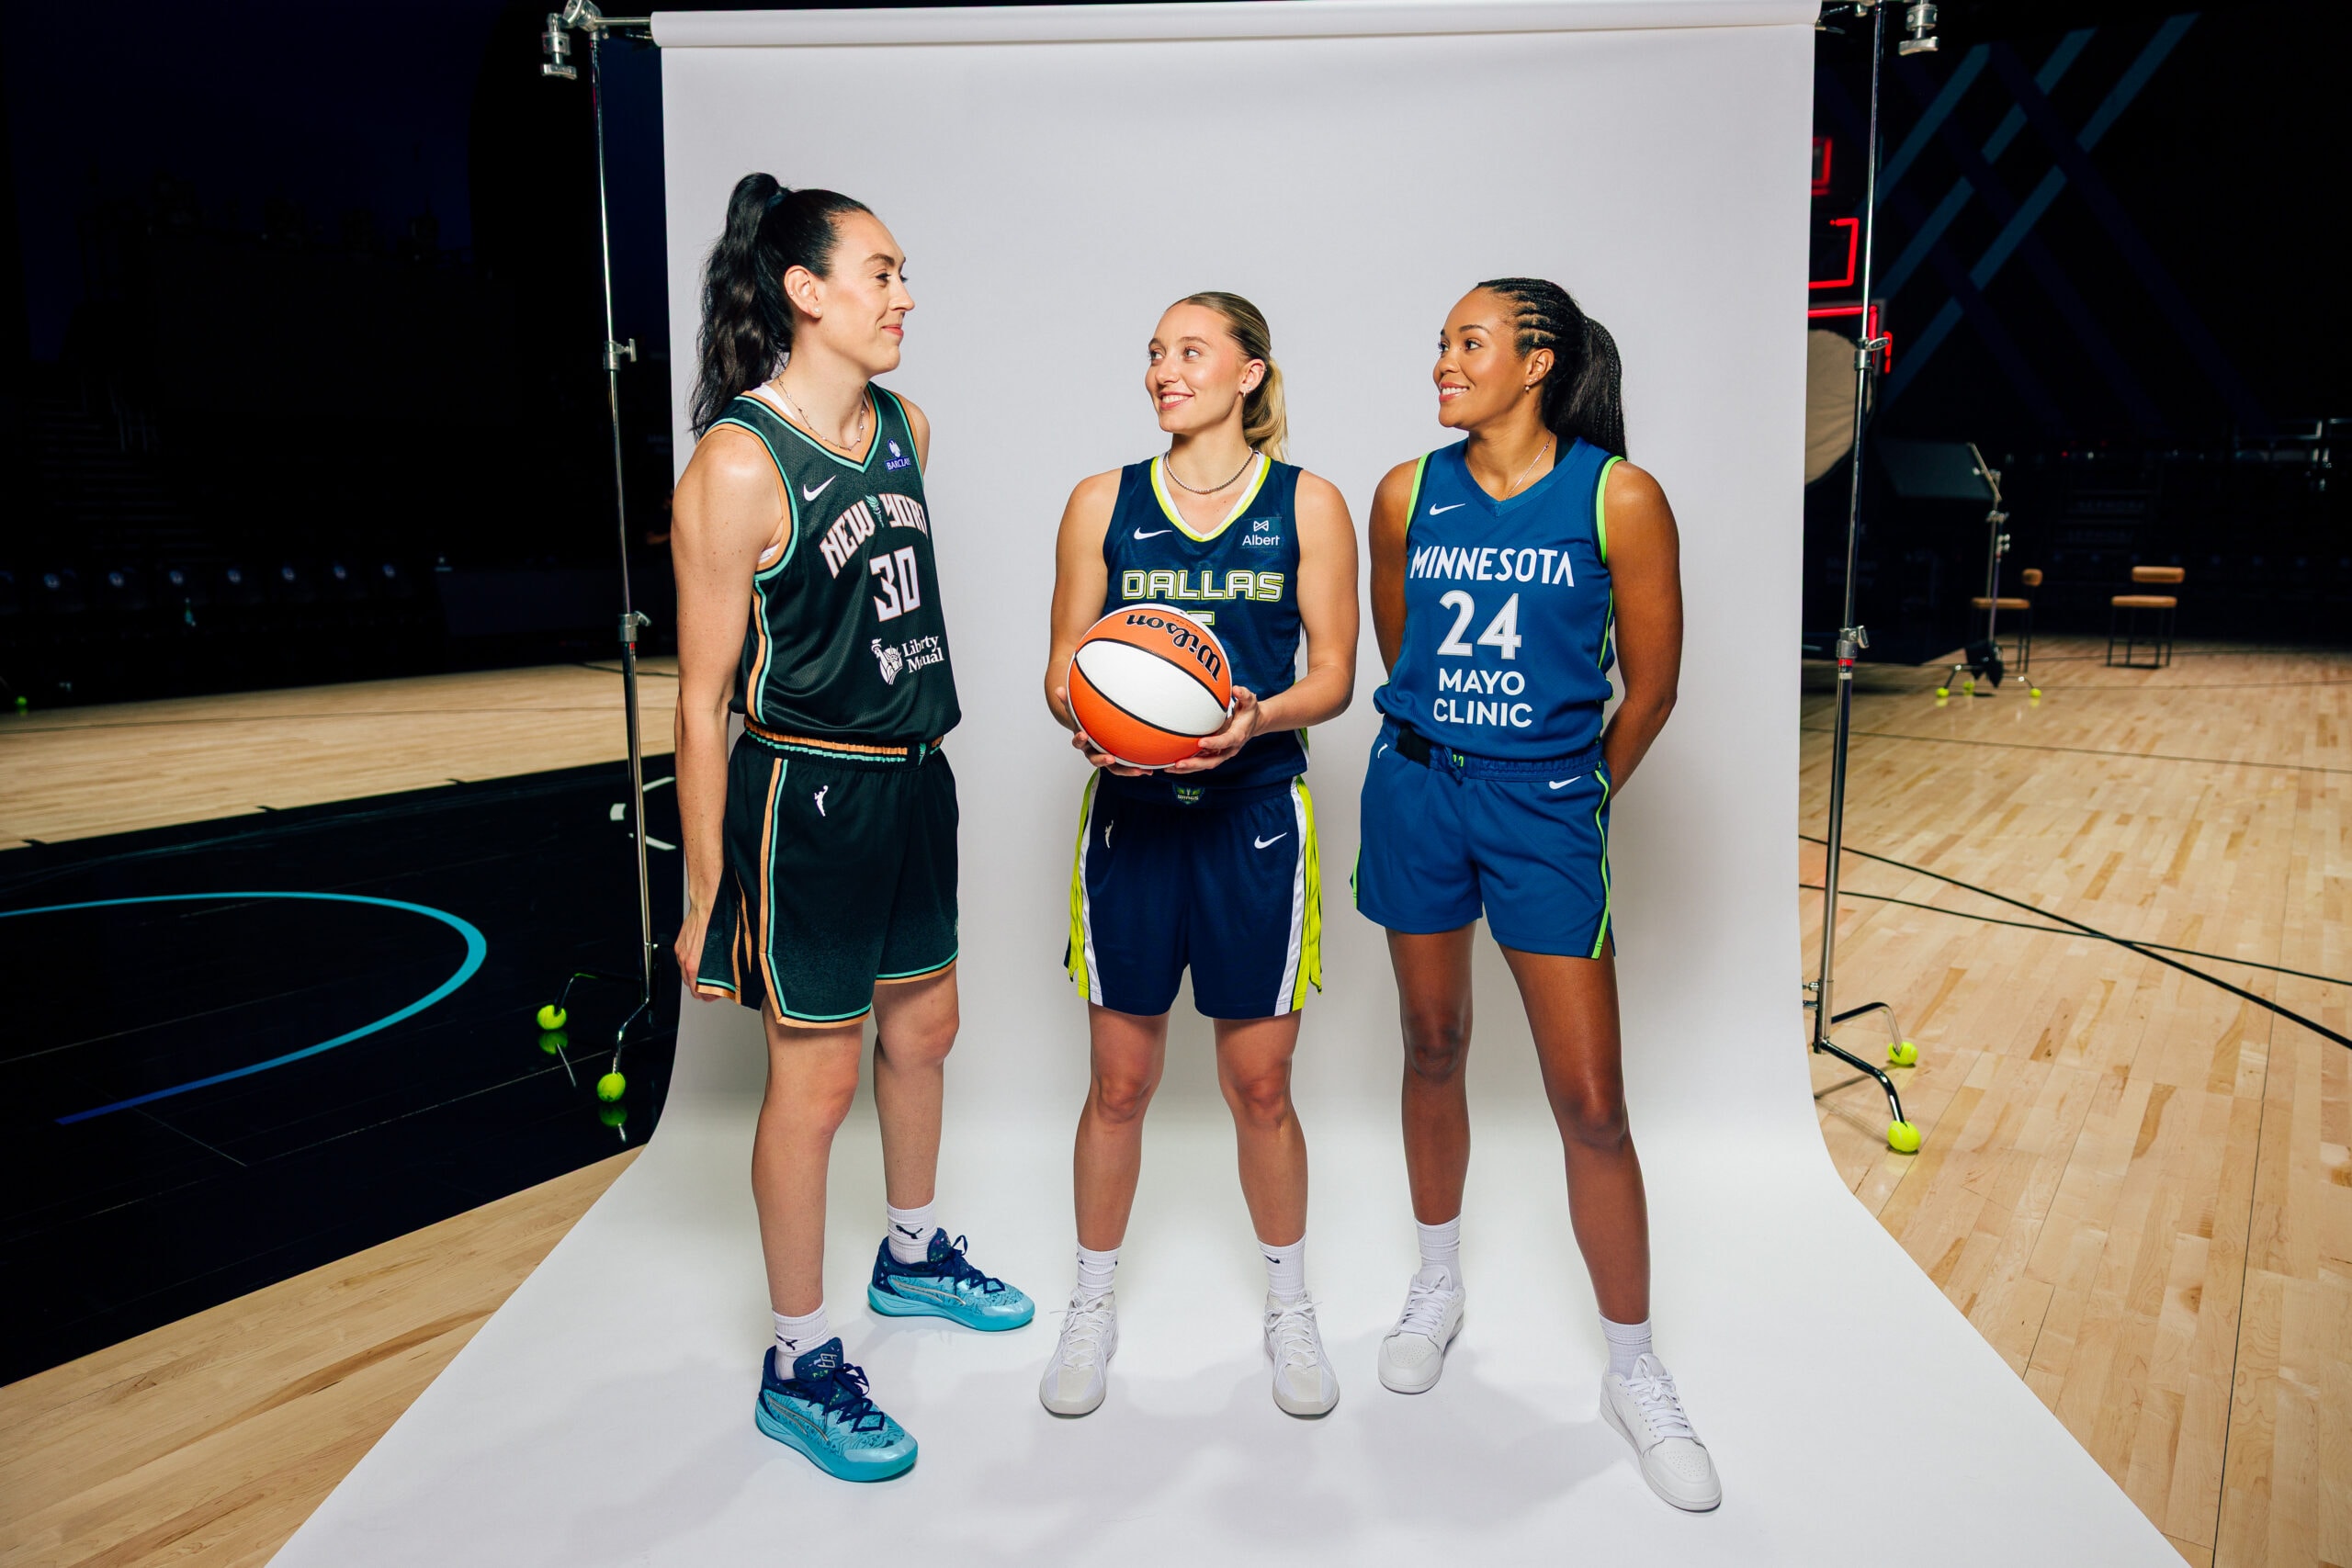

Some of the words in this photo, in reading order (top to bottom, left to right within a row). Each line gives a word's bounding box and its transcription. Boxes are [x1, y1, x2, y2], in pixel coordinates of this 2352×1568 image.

[819, 500, 876, 580] NEW
[1242, 534, 1281, 547] Albert
[869, 546, 921, 623] 30
[1122, 570, 1284, 603] DALLAS
[1409, 546, 1575, 588] MINNESOTA
[1436, 590, 1522, 660] 24
[1125, 614, 1222, 682] Wilson
[1439, 668, 1525, 695] MAYO
[1433, 698, 1532, 728] CLINIC
